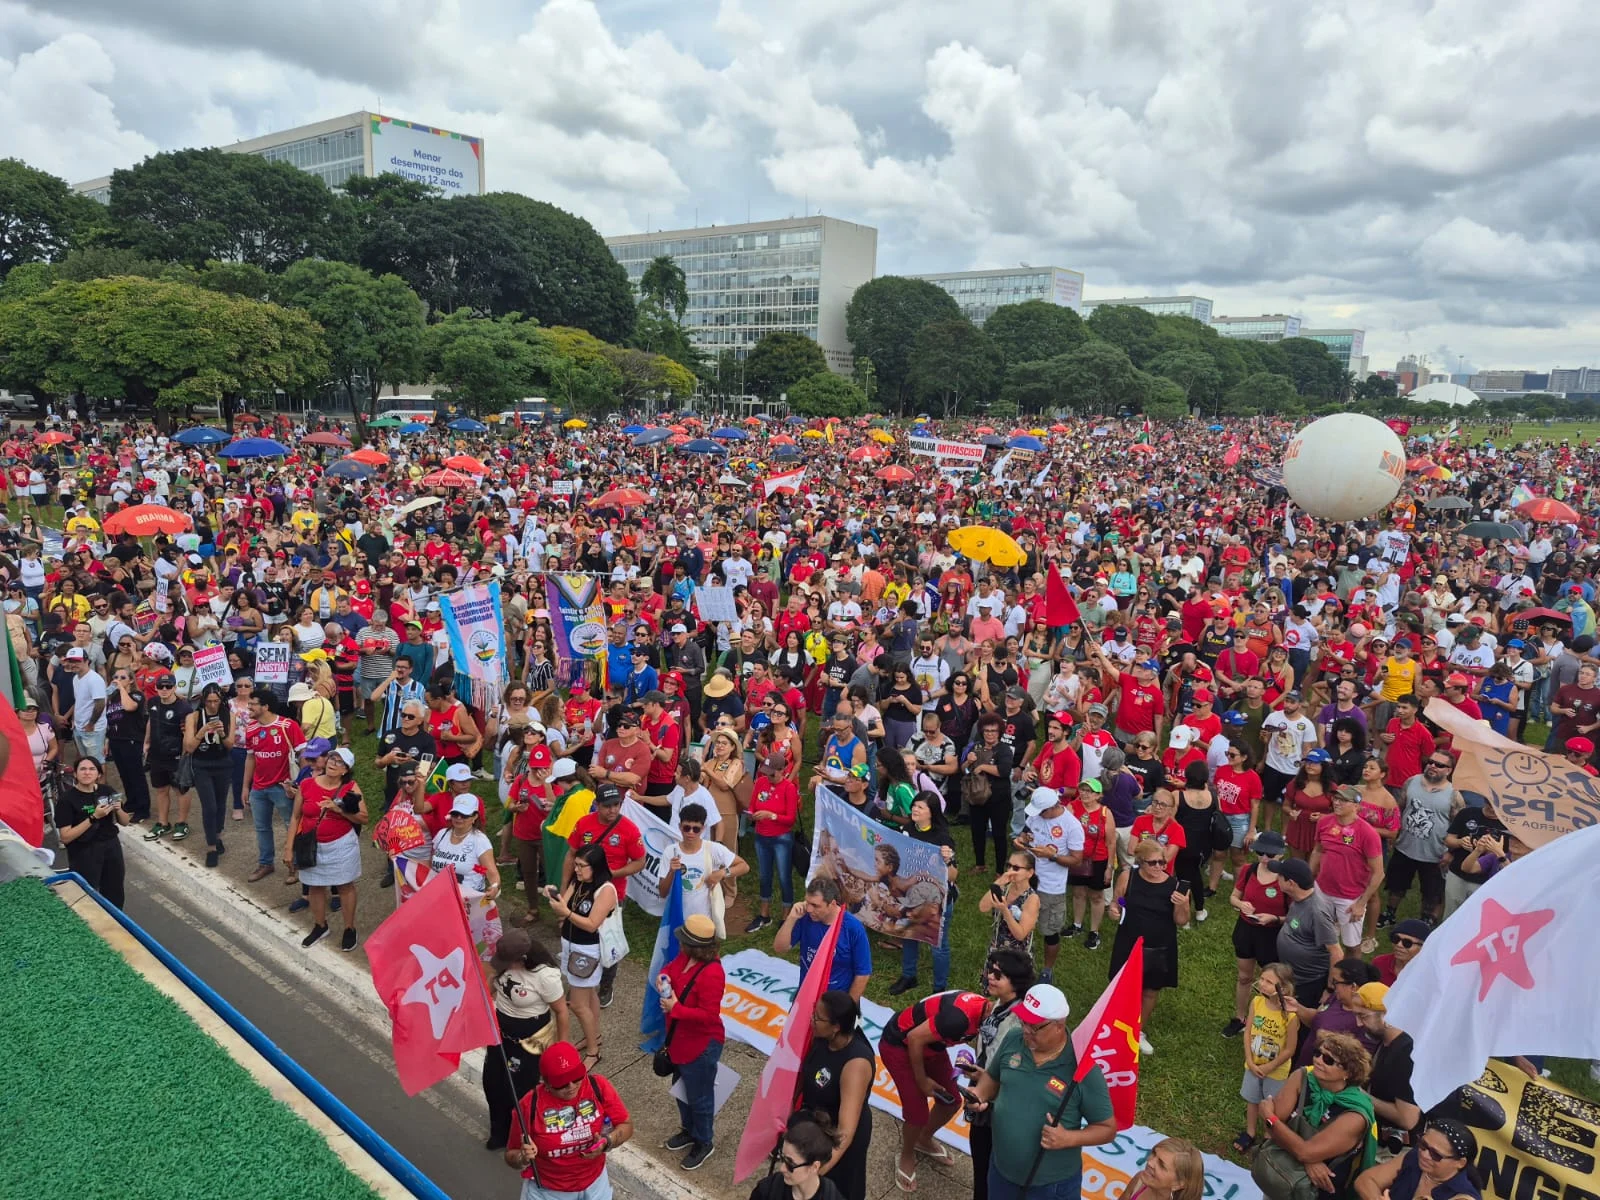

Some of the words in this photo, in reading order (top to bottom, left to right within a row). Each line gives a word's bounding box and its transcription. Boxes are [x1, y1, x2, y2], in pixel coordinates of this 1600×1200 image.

[413, 148, 441, 162] Menor
[390, 155, 446, 176] desemprego
[448, 168, 464, 179] dos
[428, 174, 438, 185] 12
[937, 443, 983, 458] ANTIFASCISTA
[135, 512, 176, 525] BRAHMA
[258, 647, 287, 663] SEM
[256, 662, 288, 673] ANISTIA!
[722, 992, 768, 1021] OVO
[1025, 993, 1041, 1009] CTB
[1050, 1079, 1065, 1091] CTB
